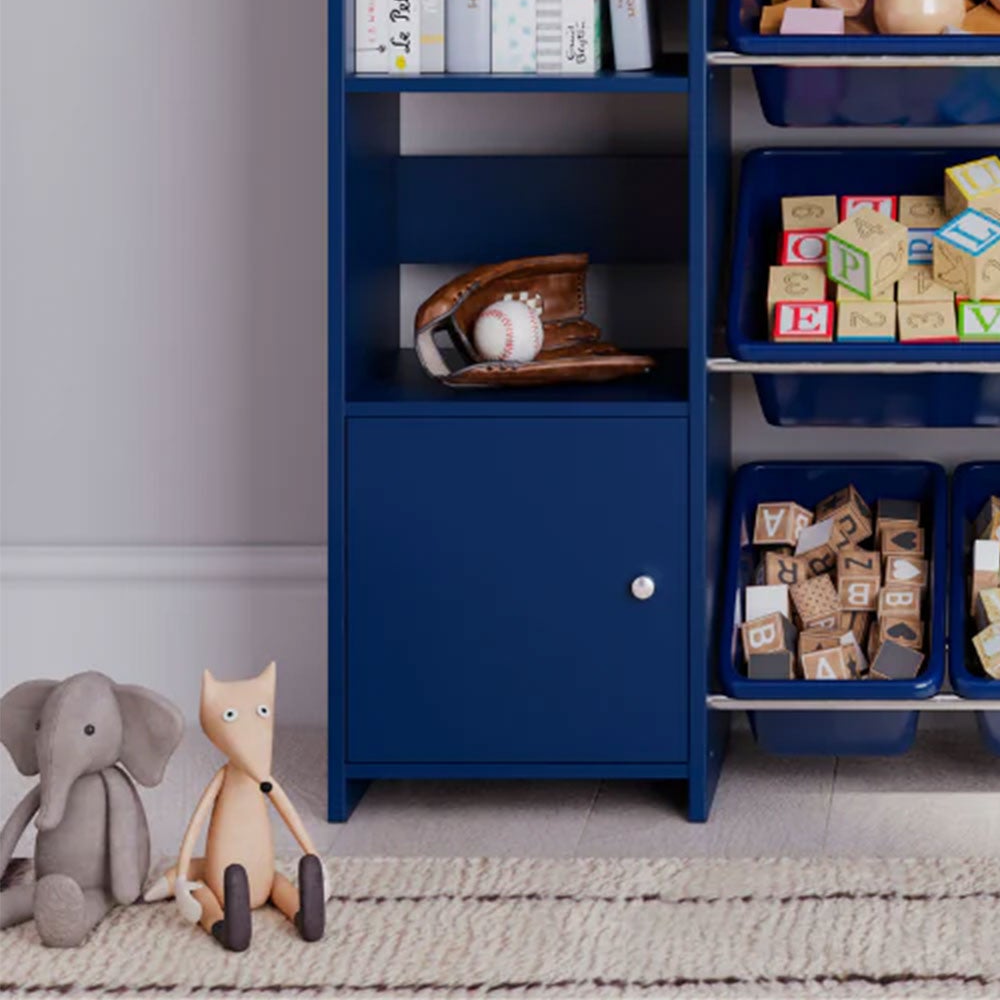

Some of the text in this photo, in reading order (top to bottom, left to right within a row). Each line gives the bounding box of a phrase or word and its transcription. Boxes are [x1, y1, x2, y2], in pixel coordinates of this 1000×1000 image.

[390, 31, 412, 53] Le
[838, 244, 860, 281] P
[787, 305, 822, 333] E
[762, 509, 785, 537] A
[847, 583, 870, 606] B
[749, 624, 776, 648] B
[815, 657, 838, 680] A
